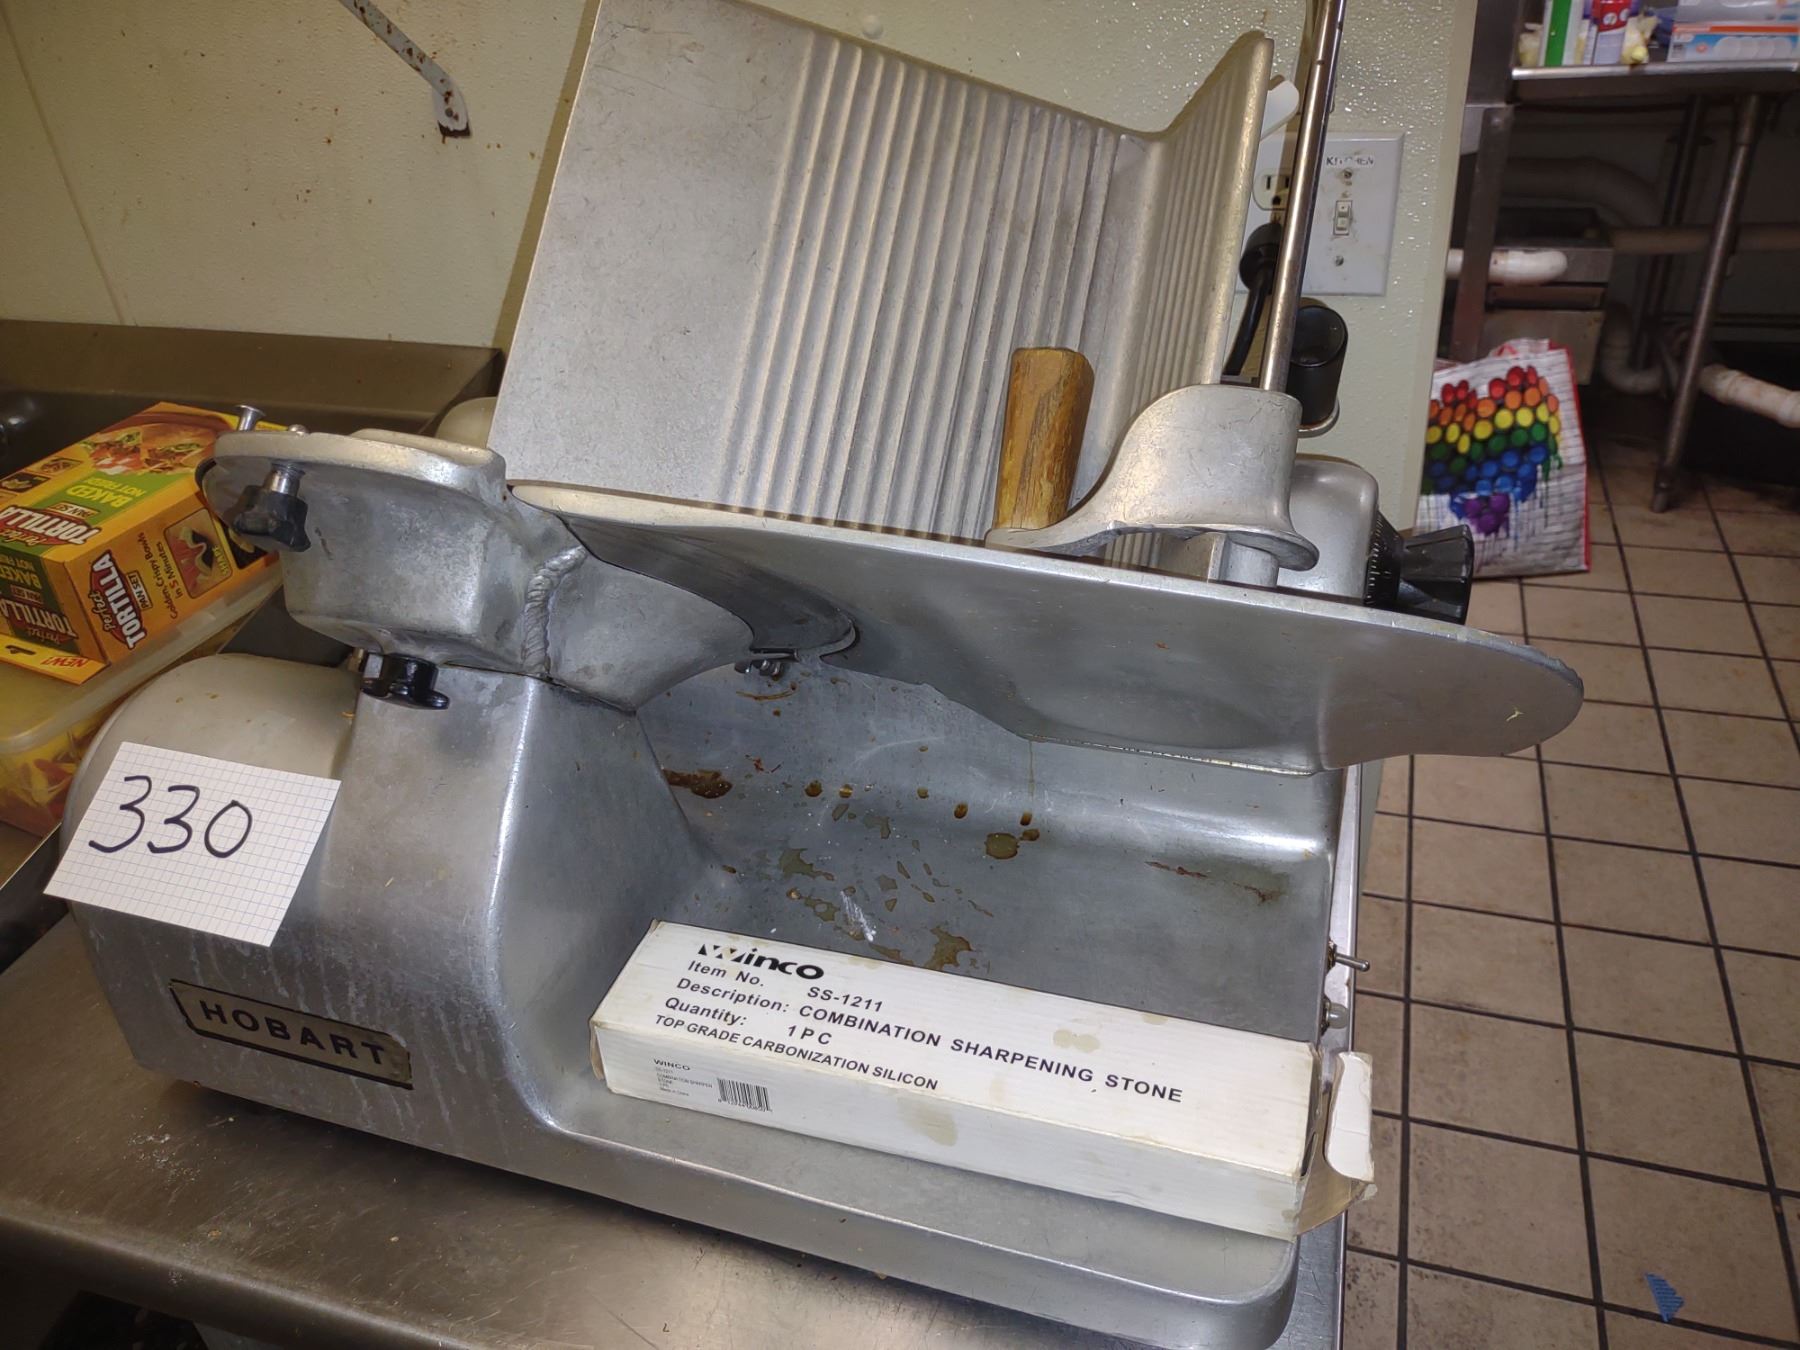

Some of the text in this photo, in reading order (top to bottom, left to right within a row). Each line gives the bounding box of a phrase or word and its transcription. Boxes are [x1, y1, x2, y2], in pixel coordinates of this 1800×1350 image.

[66, 484, 133, 508] BAKED
[0, 506, 101, 545] TORTILLA
[0, 565, 42, 589] BAKE
[138, 532, 178, 619] Golden, Crispy Bowls
[156, 541, 174, 580] Minutes
[92, 552, 147, 649] TORTILLA
[129, 574, 149, 609] PAN SET
[169, 579, 179, 588] 5
[0, 600, 78, 638] TORTILLA
[41, 656, 88, 668] NEW!
[88, 775, 253, 859] 330
[687, 960, 883, 1013] Item No. SS-1211
[665, 997, 748, 1026] Quantity:
[199, 999, 385, 1065] HOBART
[676, 977, 1183, 1103] Description: COMBINATION SHARPENING STONE
[654, 1058, 691, 1071] WINCO
[655, 1014, 939, 1091] TOP GRADE CARBONIZATION SILICON
